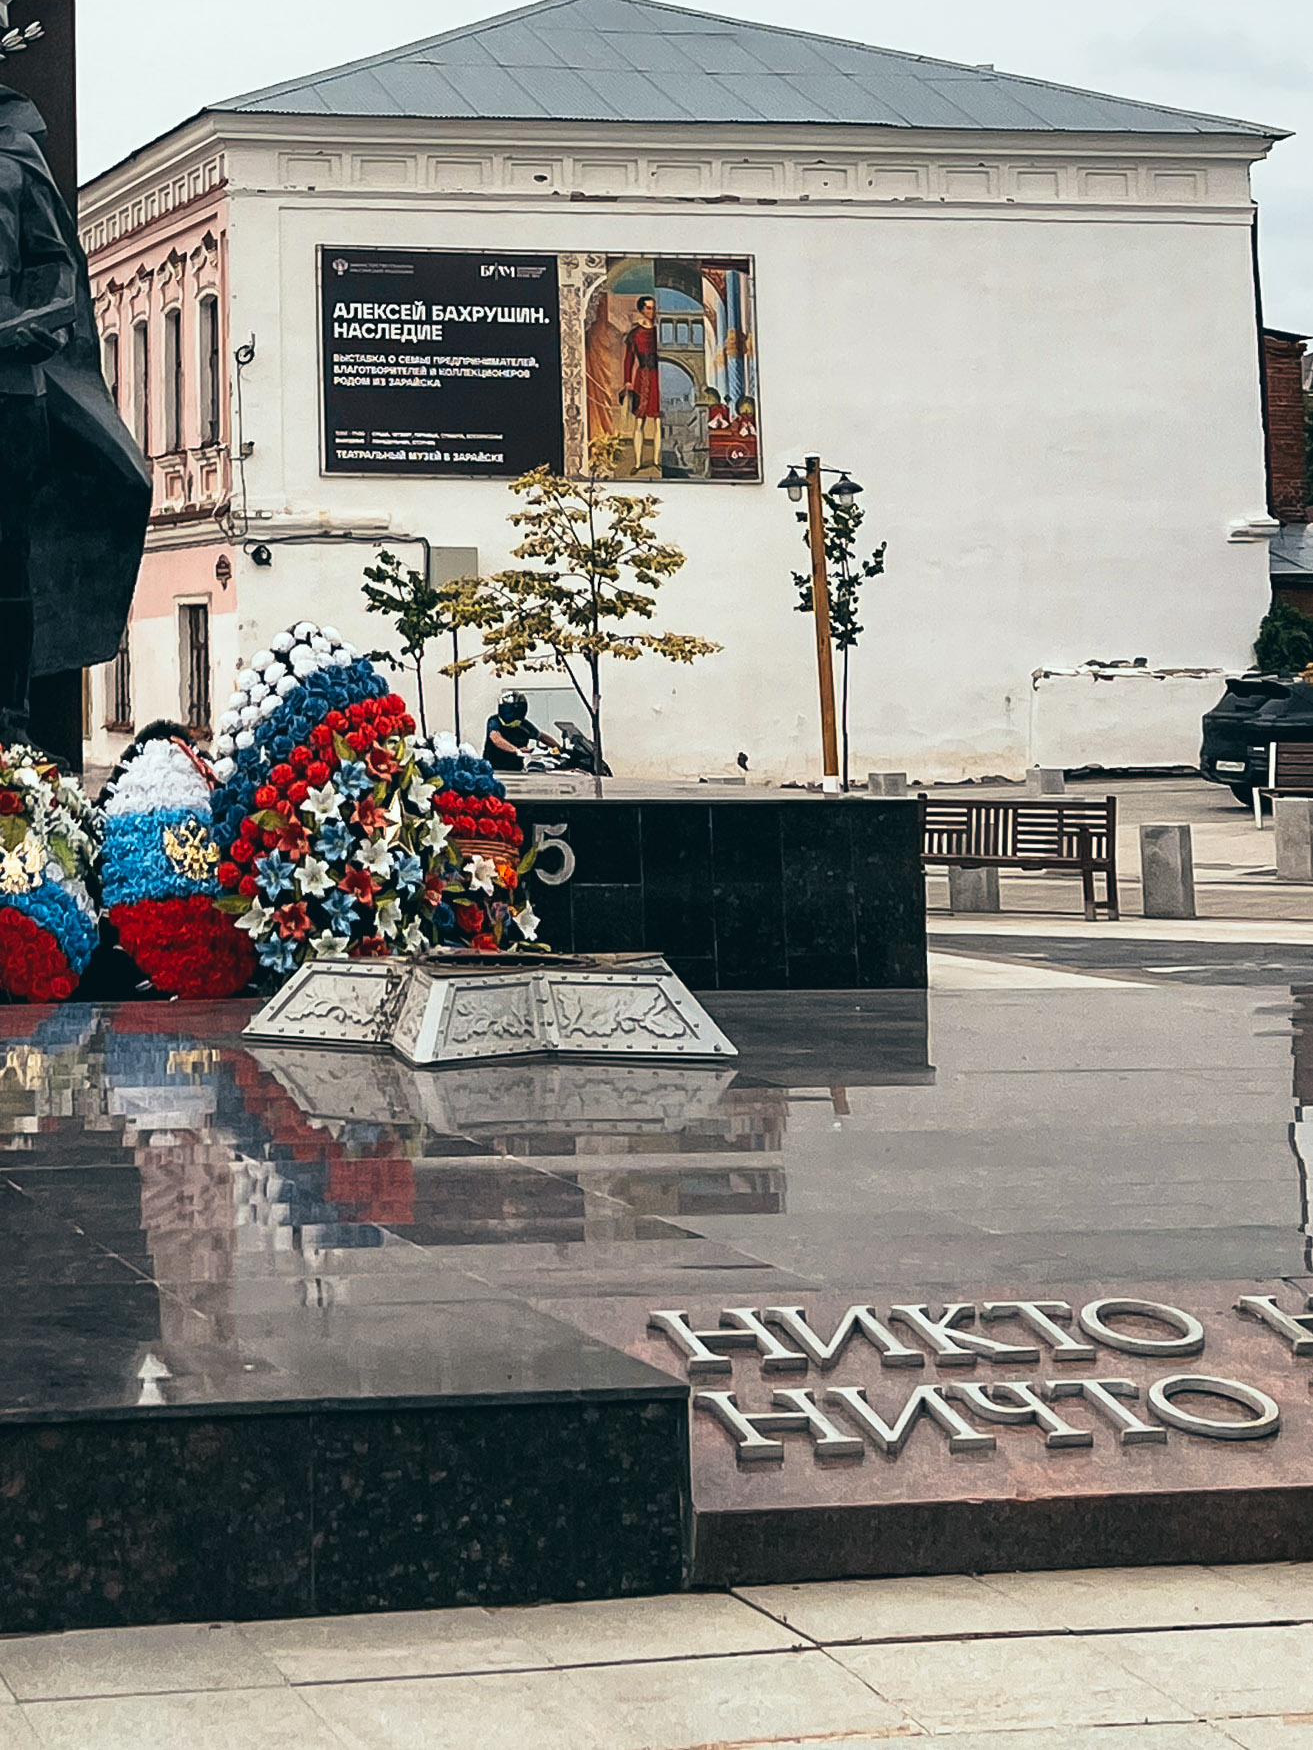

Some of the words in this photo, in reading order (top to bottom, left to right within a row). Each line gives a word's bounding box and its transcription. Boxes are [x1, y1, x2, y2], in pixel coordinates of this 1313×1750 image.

[333, 300, 426, 321] АЛЕКСЕЙ
[432, 305, 550, 324] БАХРУШИН.
[333, 321, 443, 343] НАСЛЕДИЕ
[333, 354, 386, 364] ВЫСТАВКА
[387, 355, 396, 364] О
[333, 365, 428, 376] БЛАГОТВОРИТЕЛЕЙ
[438, 367, 531, 379] КОЛЛЕКЦИОНЕРОВ
[333, 376, 371, 387] РОДОМ
[388, 376, 441, 388] ЗАРАЙСКА
[336, 449, 406, 460] ТЕАТРАЛЬНЫЙ
[408, 450, 442, 461] МУЗЕЙ
[648, 1297, 1205, 1370] НИКТО
[694, 1375, 1282, 1461] НИЧТО
